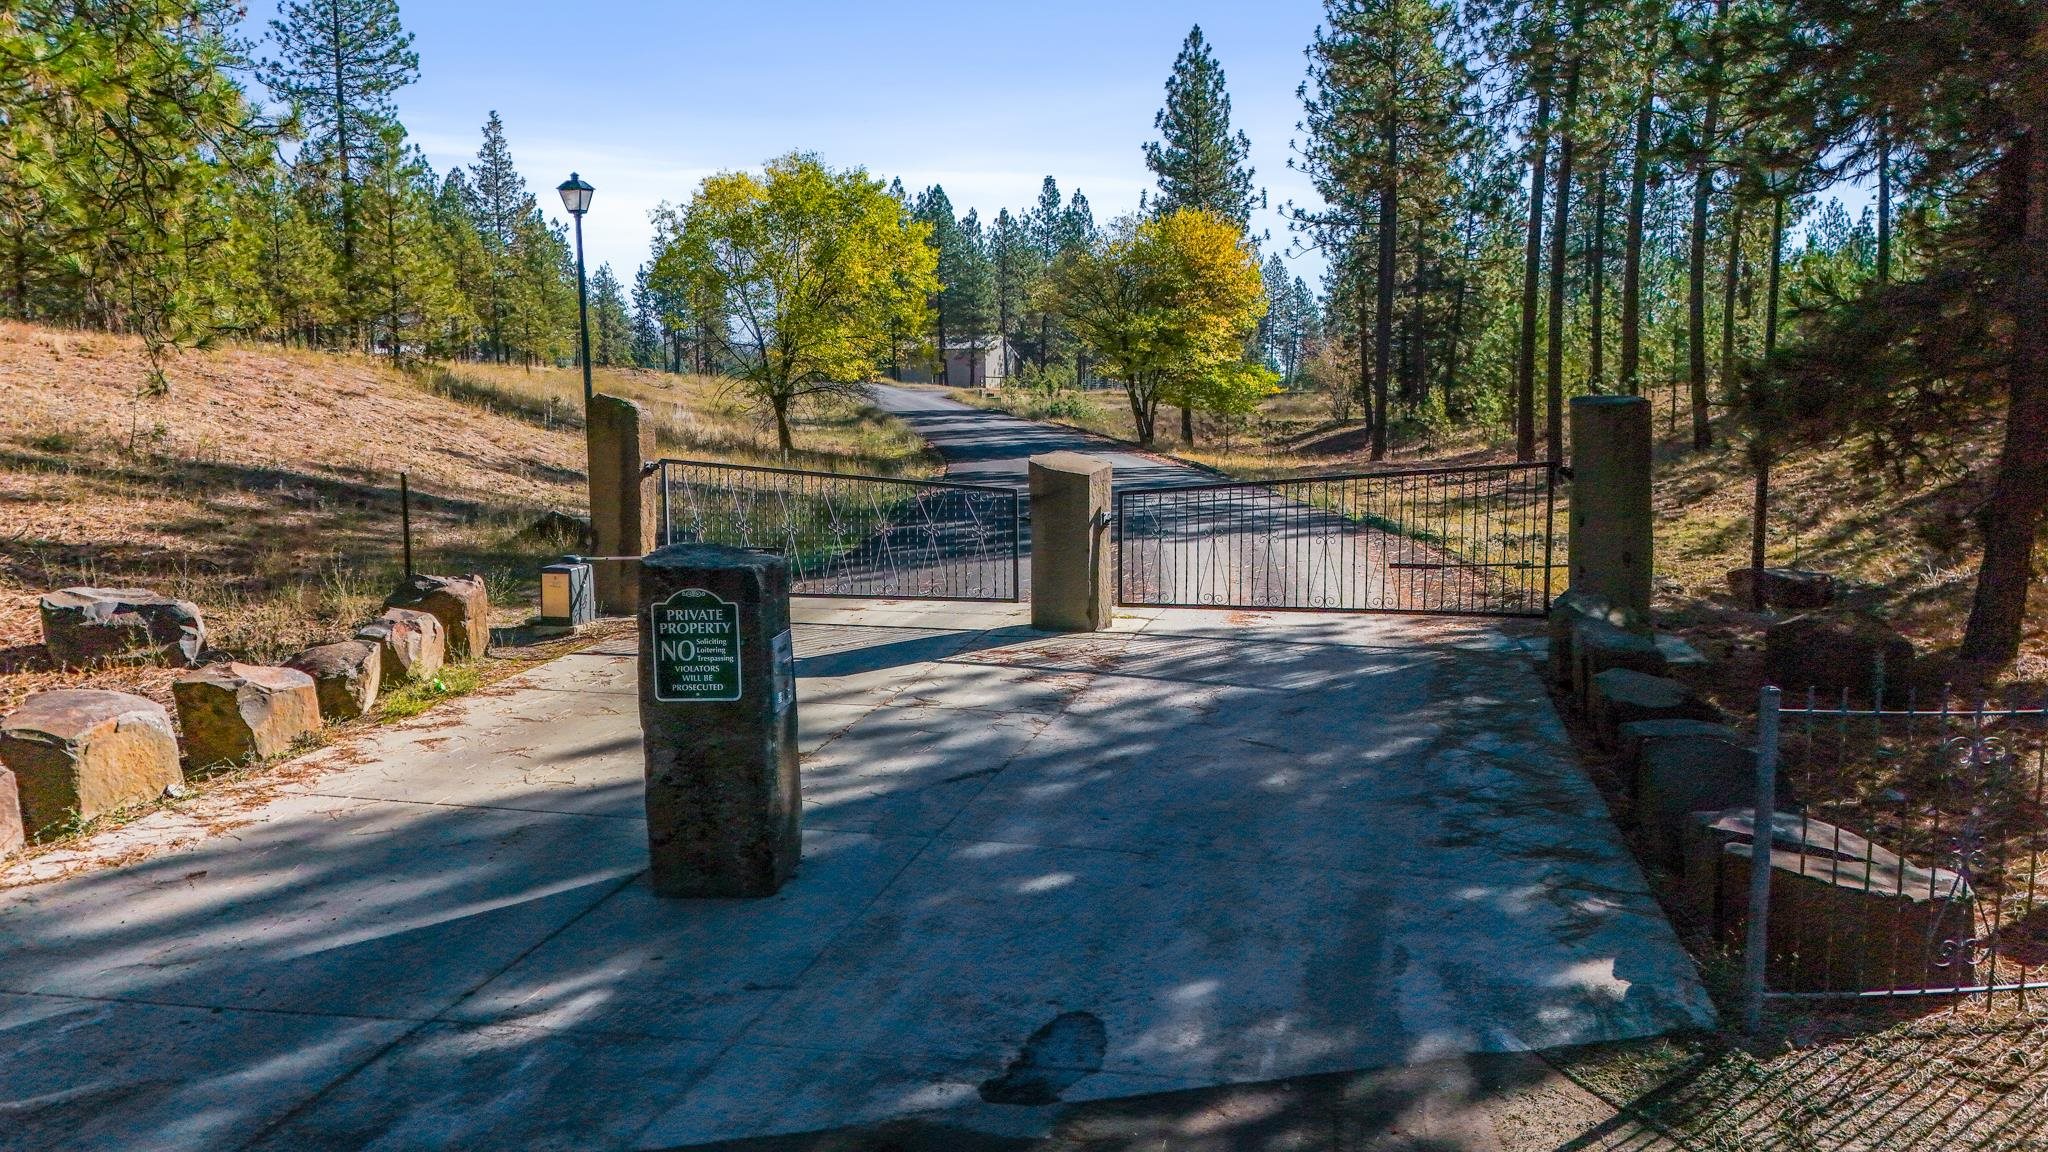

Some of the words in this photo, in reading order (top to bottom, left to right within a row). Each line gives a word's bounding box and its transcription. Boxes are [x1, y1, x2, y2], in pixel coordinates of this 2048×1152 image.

[667, 609, 723, 621] PRIVATE
[660, 622, 731, 634] PROPERTY
[661, 640, 696, 661] NO
[675, 665, 720, 673] VIOLATORS
[682, 674, 701, 682] WILL
[703, 674, 713, 682] BE
[672, 683, 724, 691] PROSECUTED
